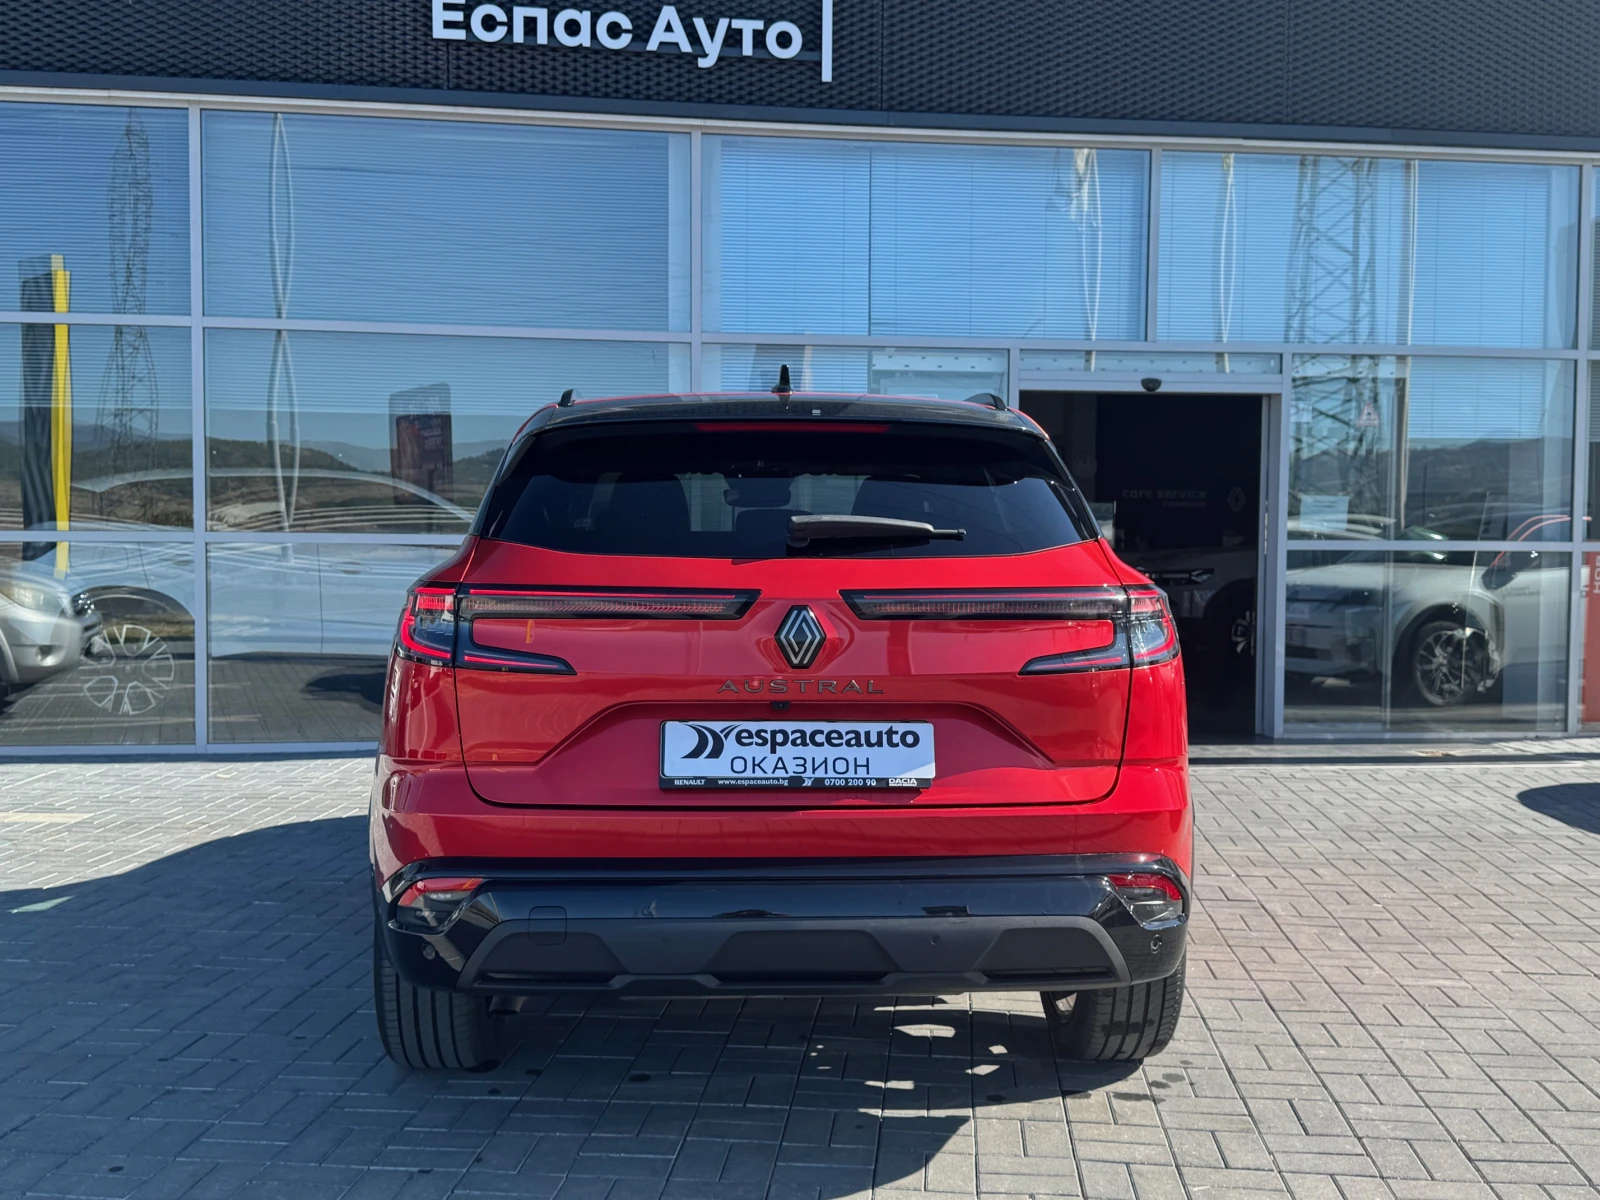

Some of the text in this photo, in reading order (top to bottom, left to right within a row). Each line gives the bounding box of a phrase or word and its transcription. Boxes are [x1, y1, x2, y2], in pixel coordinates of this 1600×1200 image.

[432, 0, 803, 68] Еспас Ауто
[717, 679, 885, 694] AUSTRAL
[734, 725, 920, 754] espaceauto
[730, 755, 870, 775] ОКАЗИОН
[717, 778, 789, 787] www.espaceauto.bg
[824, 778, 877, 786] 0700 200 90
